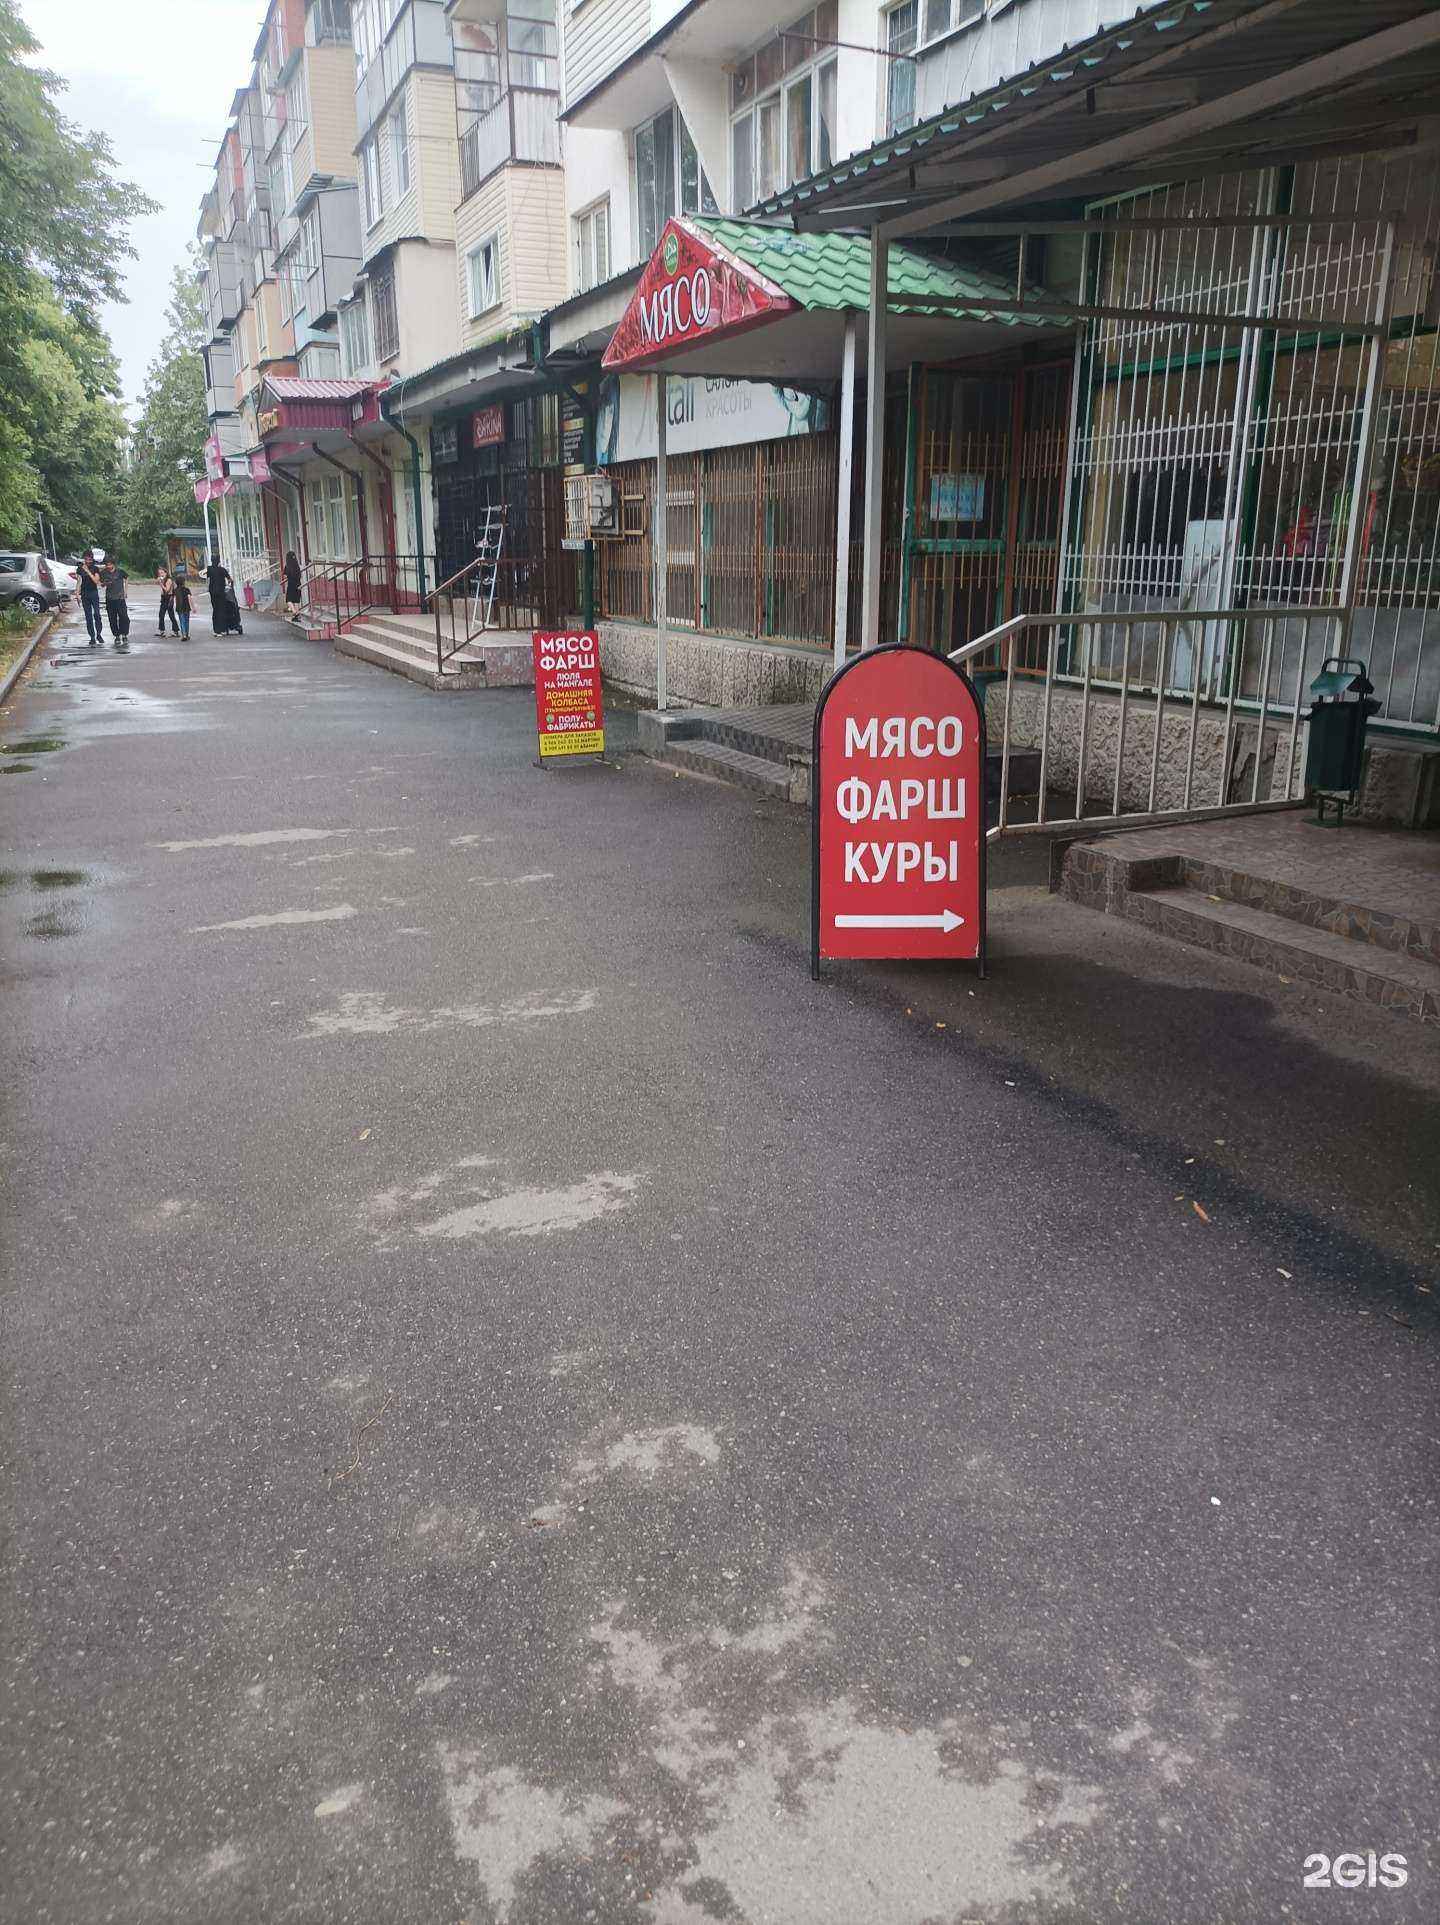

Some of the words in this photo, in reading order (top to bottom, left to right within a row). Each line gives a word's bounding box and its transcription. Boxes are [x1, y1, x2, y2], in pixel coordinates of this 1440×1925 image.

[639, 268, 711, 343] МЯСО
[540, 637, 593, 653] МЯСО
[540, 654, 594, 670] ФАРШ
[544, 680, 556, 689] НА
[557, 678, 593, 688] МАНГАЛЕ
[546, 690, 593, 699] ДОМАШНЯЯ
[552, 698, 588, 706] КОЛБАСА
[547, 721, 596, 731] ФАБРИКАТЫ
[844, 716, 963, 757] МЯСО
[836, 776, 965, 823] ФАРШ
[844, 840, 959, 883] КУРЫ
